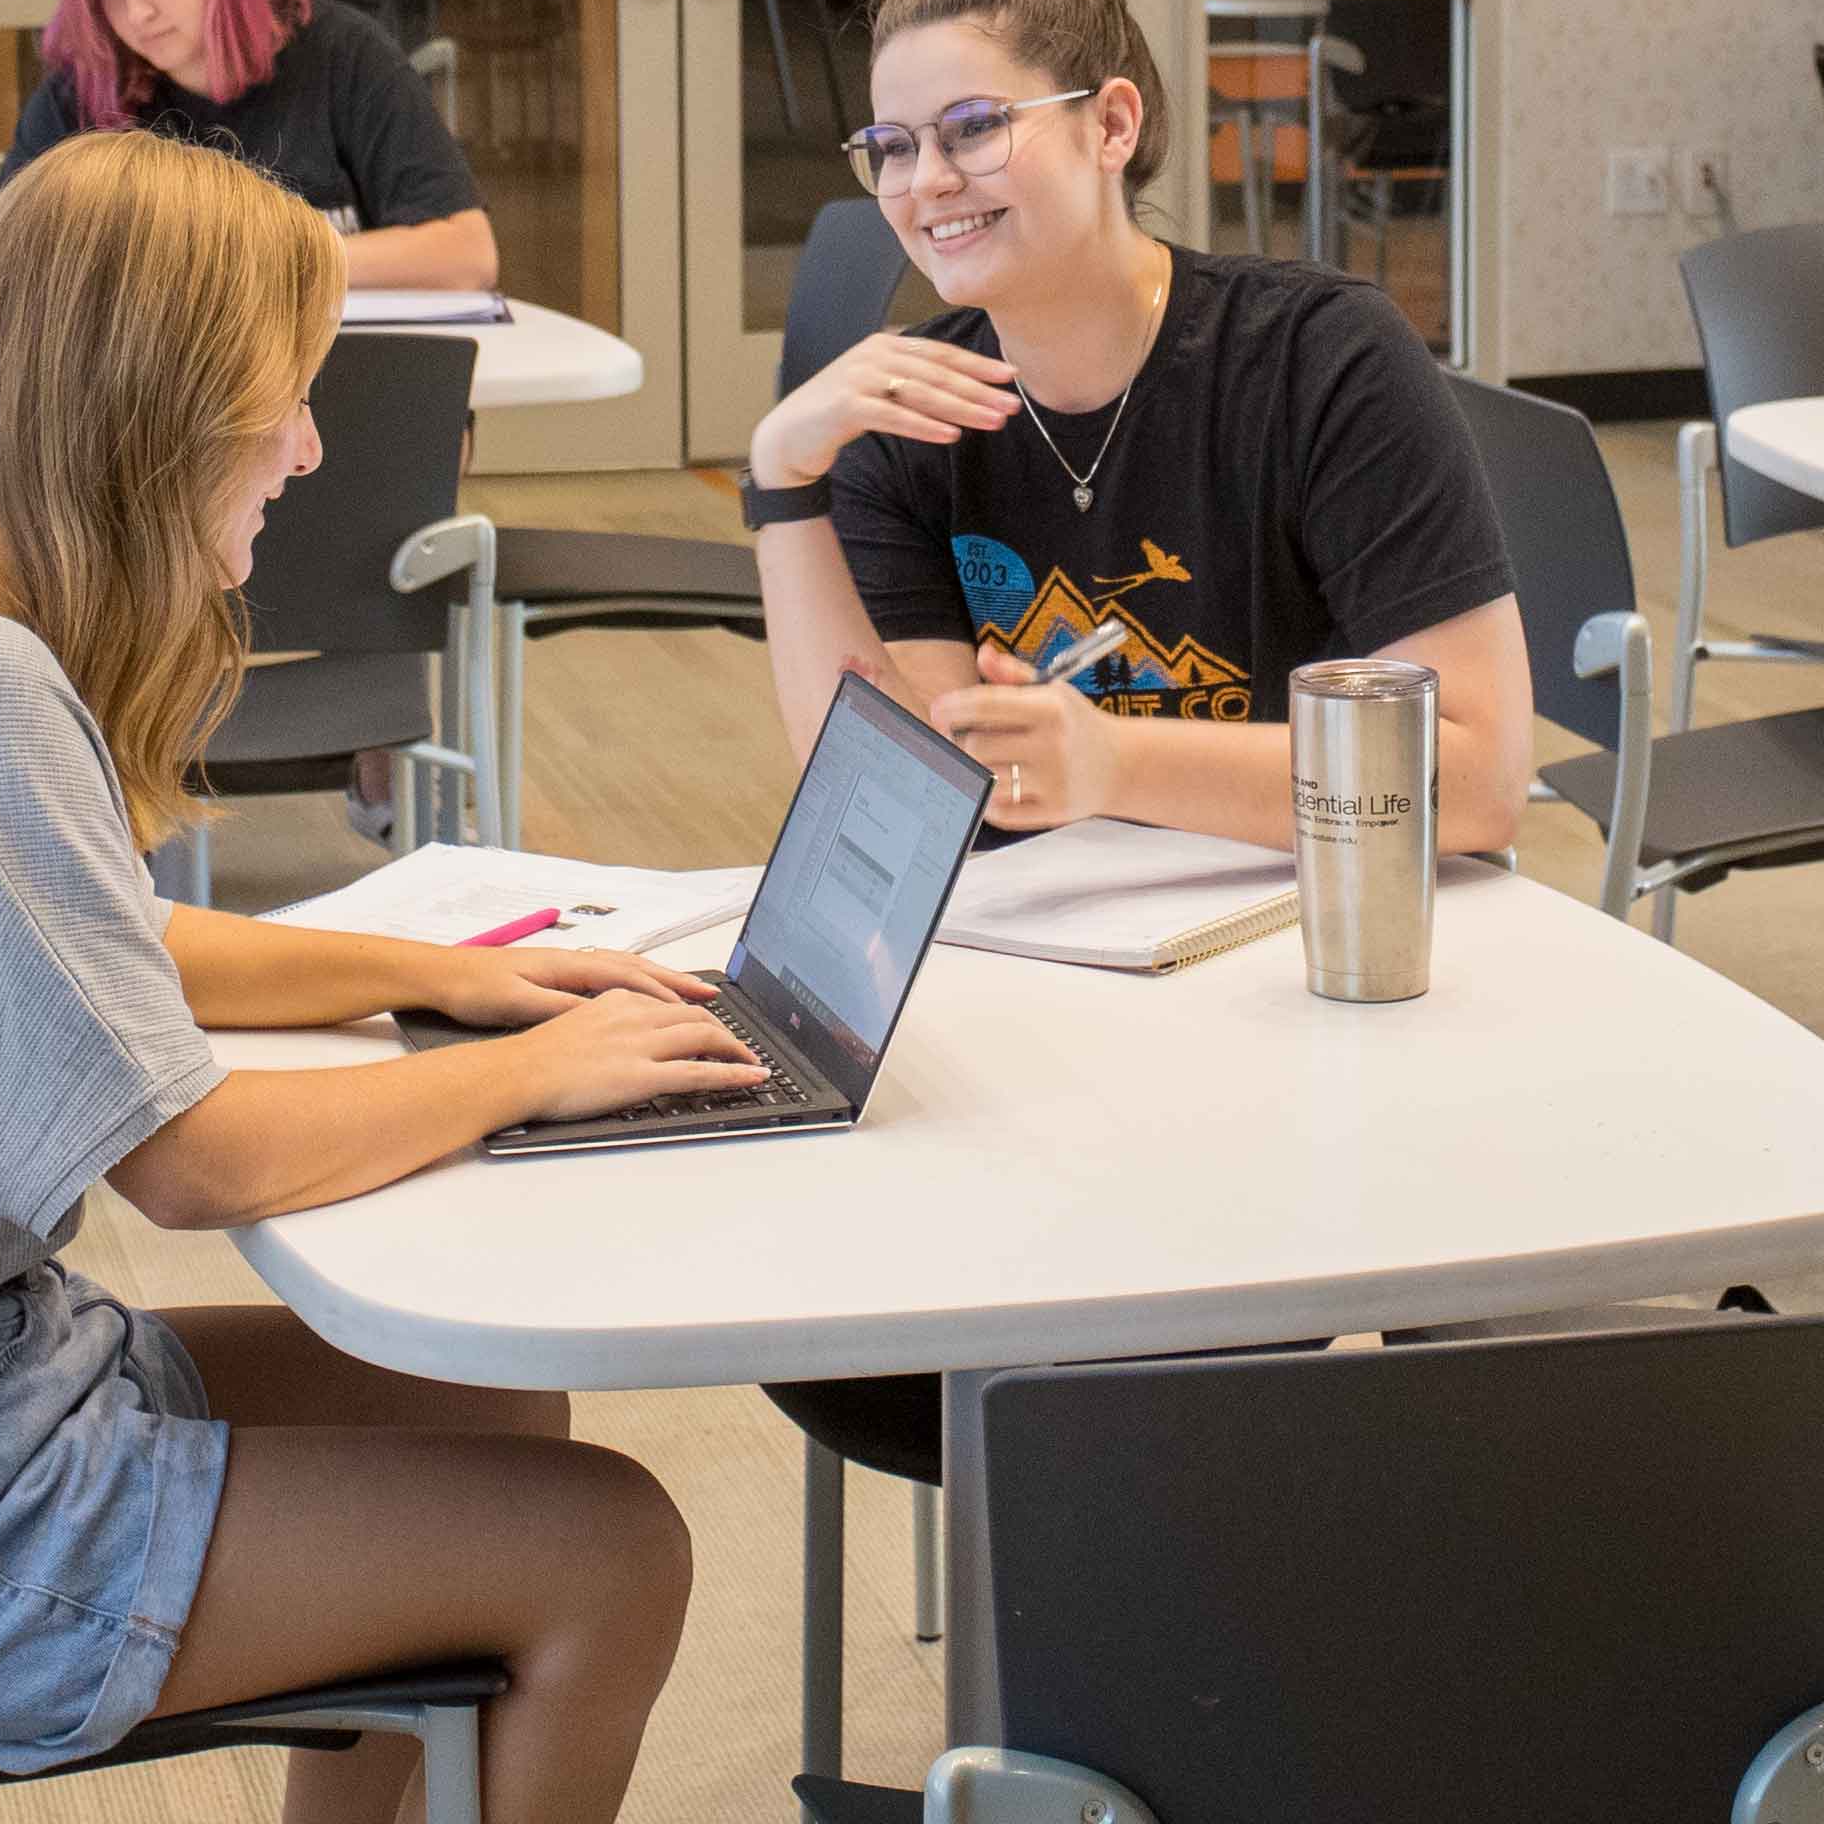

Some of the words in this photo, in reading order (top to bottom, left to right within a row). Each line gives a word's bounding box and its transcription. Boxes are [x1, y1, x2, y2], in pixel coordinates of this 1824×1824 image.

[957, 560, 1008, 586] 003
[1295, 789, 1362, 815] dential
[1370, 793, 1411, 816] Life
